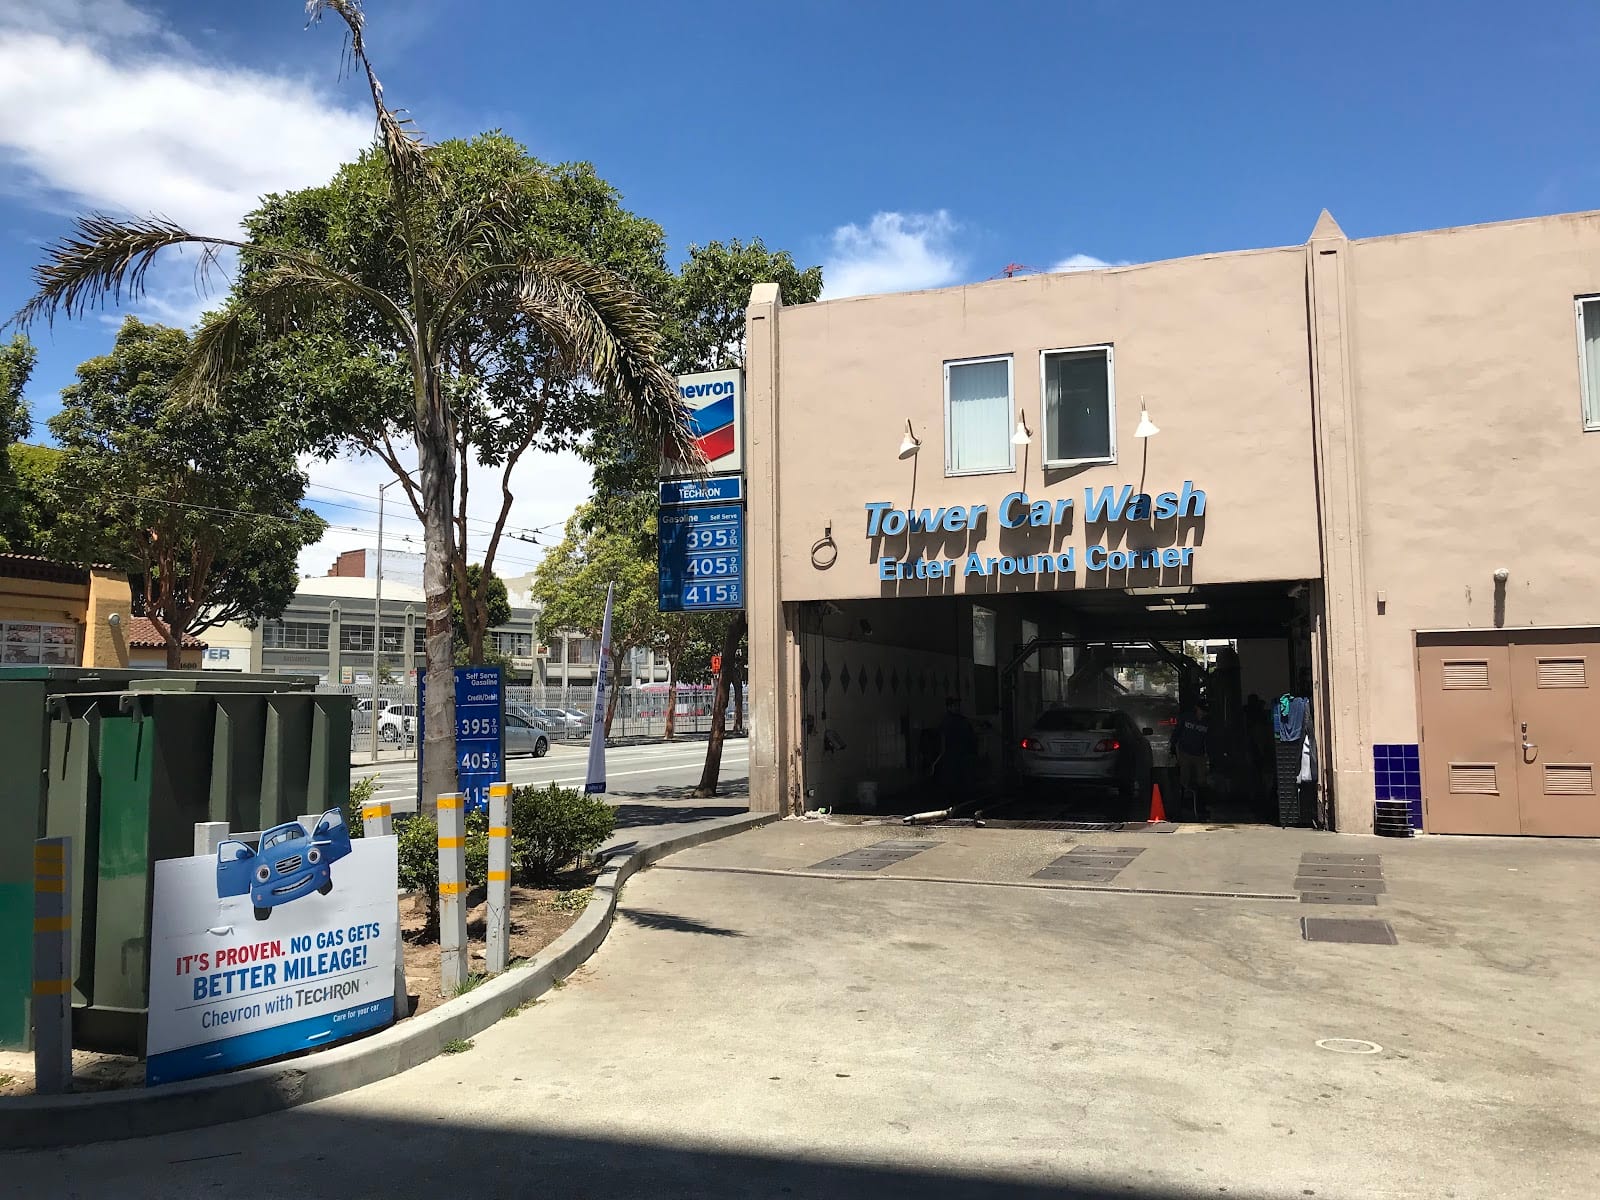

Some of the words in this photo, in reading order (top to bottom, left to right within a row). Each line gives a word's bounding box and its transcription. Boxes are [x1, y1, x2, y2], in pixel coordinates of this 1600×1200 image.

[679, 381, 735, 399] evron
[864, 502, 987, 537] Tower
[998, 491, 1074, 529] Car
[1084, 480, 1207, 523] Wash
[662, 514, 699, 523] Gasoline
[687, 530, 727, 549] 395
[687, 558, 727, 575] 405
[879, 556, 954, 580] Enter
[964, 547, 1075, 577] Around
[1085, 545, 1194, 570] Corner
[687, 586, 727, 602] 415
[479, 672, 498, 680] Serve
[467, 694, 498, 702] Credit/Debit
[461, 718, 489, 735] 395
[461, 753, 490, 769] 405
[463, 787, 490, 803] 415
[176, 953, 210, 976] IT'S
[215, 940, 286, 968] PROVEN.
[290, 935, 312, 954] NO
[316, 929, 344, 949] GAS
[348, 922, 380, 943] GETS
[193, 963, 276, 1001] BETTER
[283, 944, 368, 982] MILEAGE!
[202, 1004, 260, 1029] Chevron
[265, 995, 293, 1014] with
[295, 979, 360, 1007] TECHRON
[333, 1013, 347, 1023] Care
[347, 1010, 356, 1020] for
[357, 1007, 369, 1019] your
[370, 1004, 380, 1013] car
